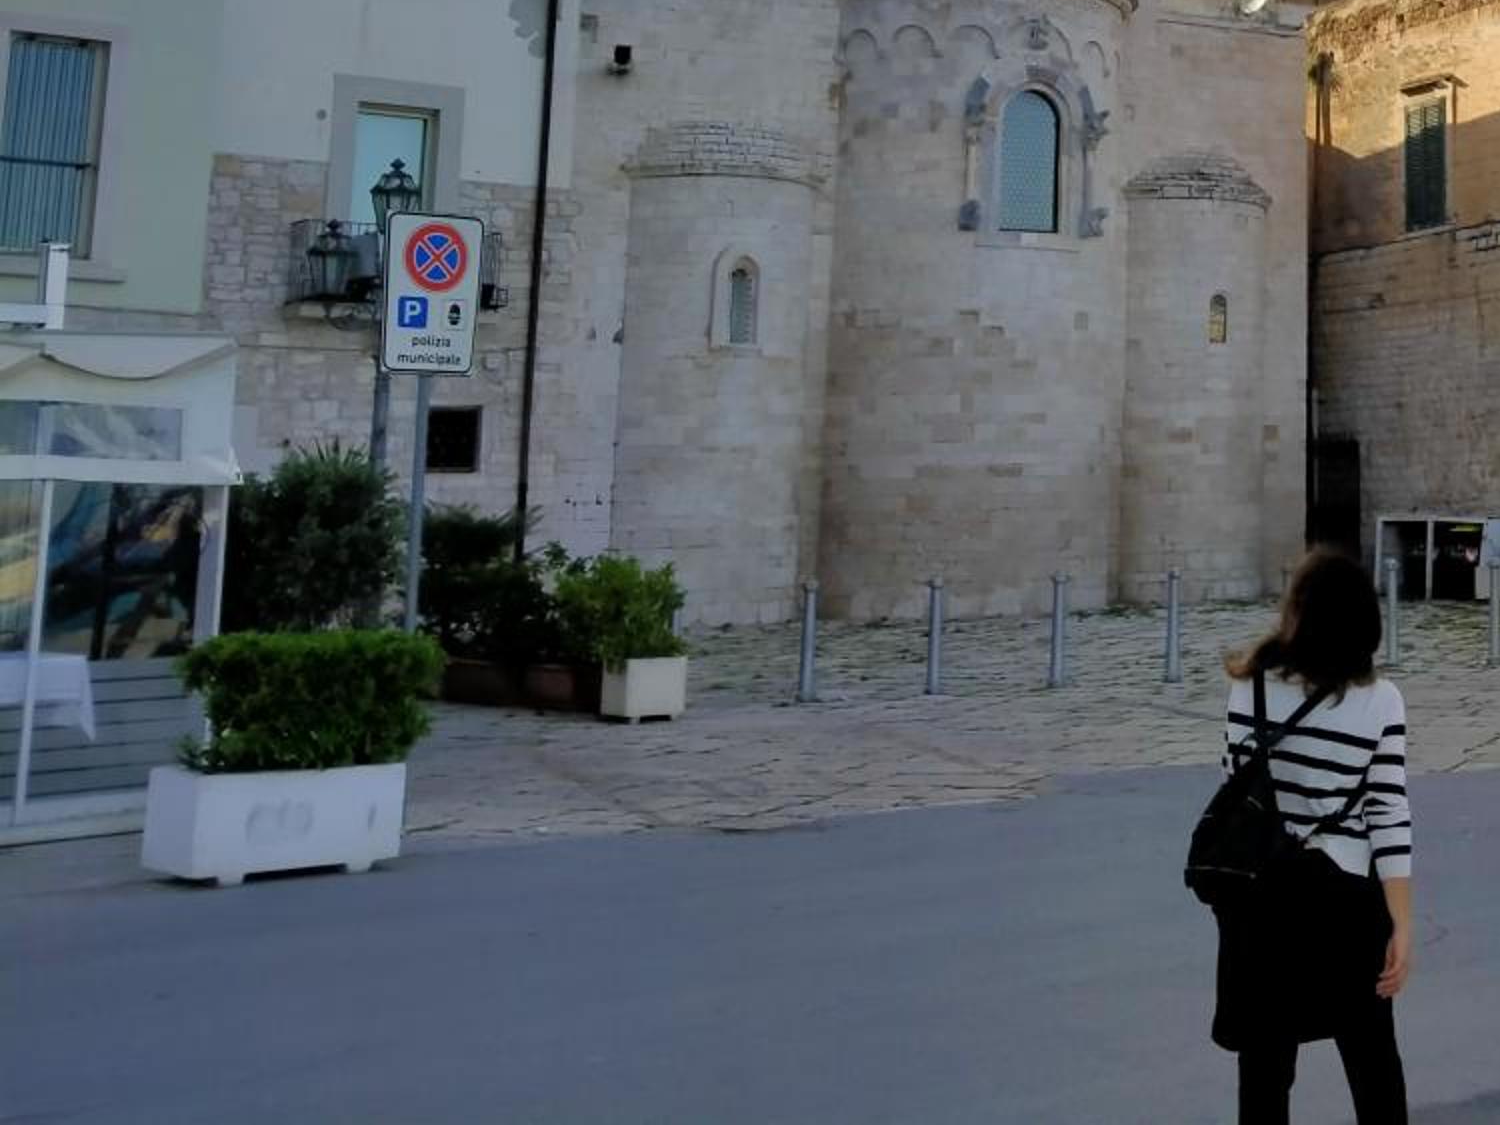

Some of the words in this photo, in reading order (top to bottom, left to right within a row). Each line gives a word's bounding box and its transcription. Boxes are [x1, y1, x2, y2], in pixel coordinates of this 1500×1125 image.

[404, 300, 421, 324] P
[412, 335, 451, 348] polizia
[397, 353, 462, 366] municipale
